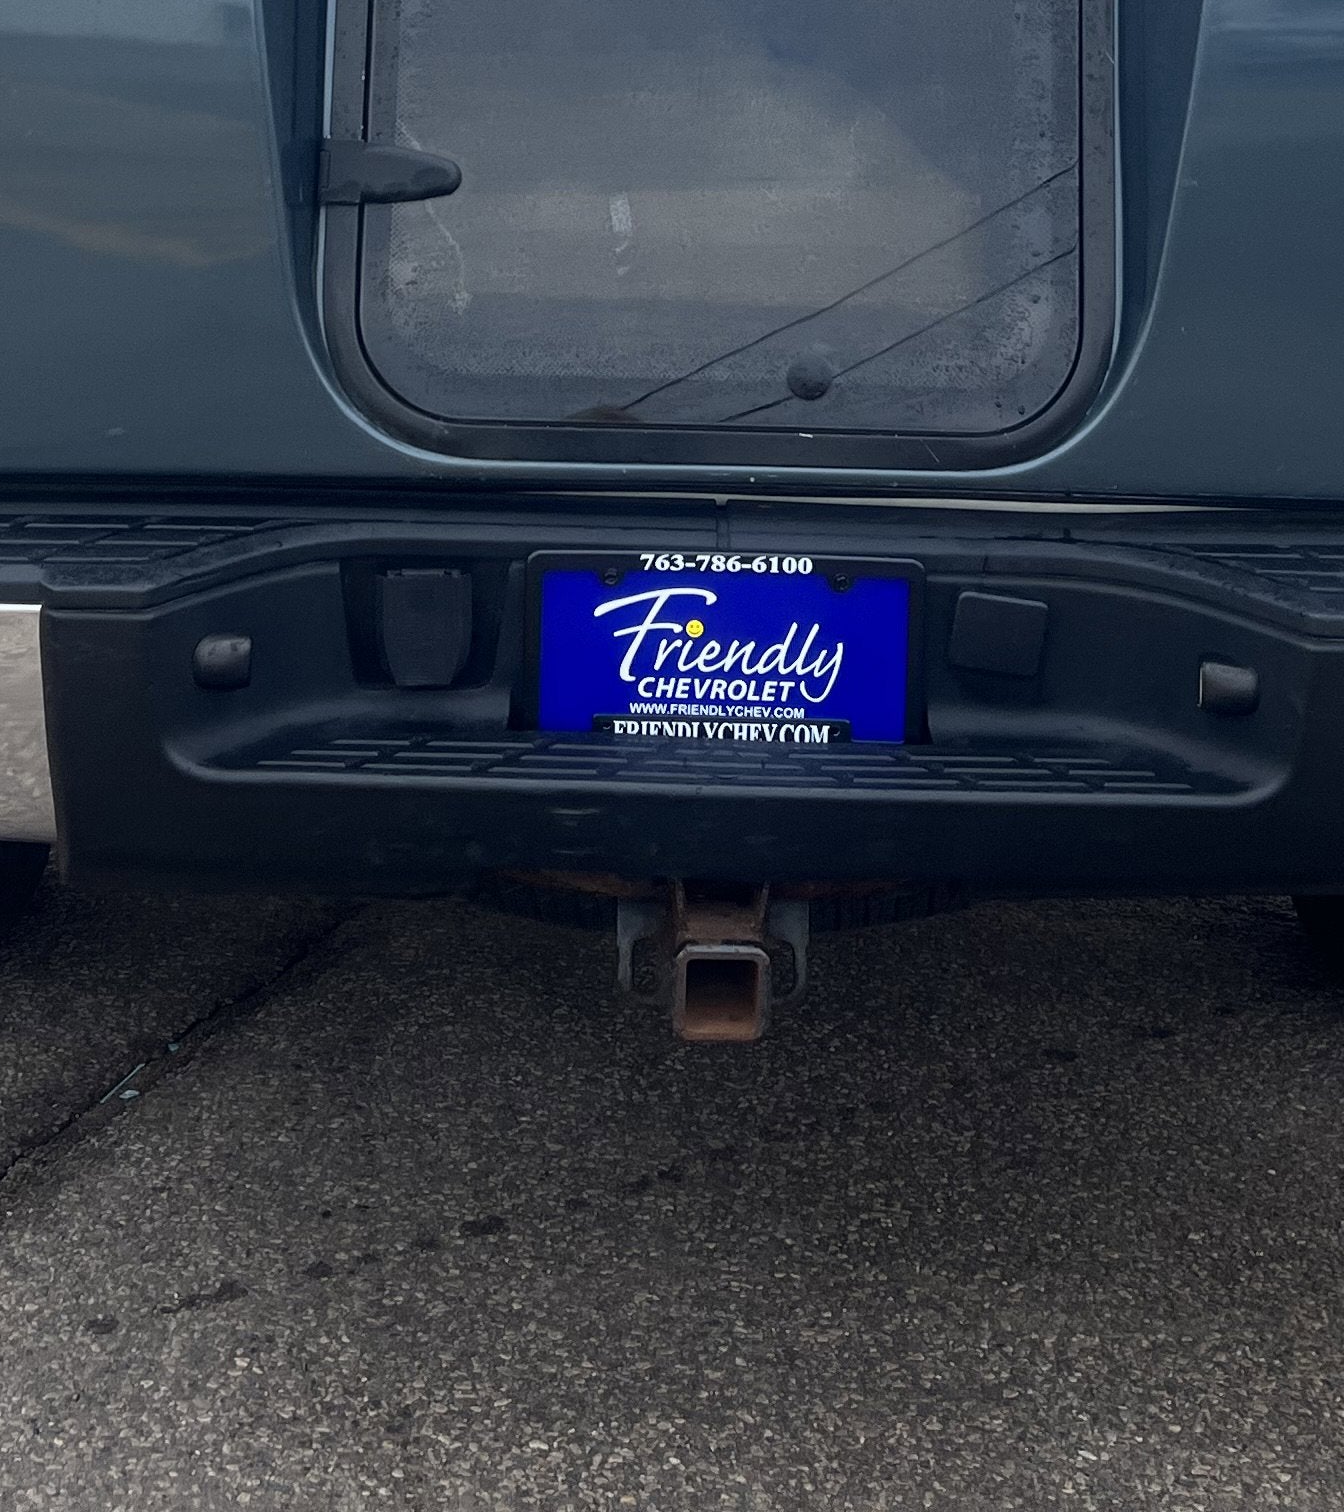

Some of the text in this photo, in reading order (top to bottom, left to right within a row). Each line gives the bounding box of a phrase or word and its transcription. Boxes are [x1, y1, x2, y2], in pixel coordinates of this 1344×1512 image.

[639, 553, 813, 575] 763-786-6100
[593, 587, 845, 703] Friendly
[637, 676, 796, 702] CHEVROLET
[629, 702, 806, 719] WWW.FRIENDLYCHEV.COM
[613, 720, 831, 744] FRIENDLYCHEVCOM
